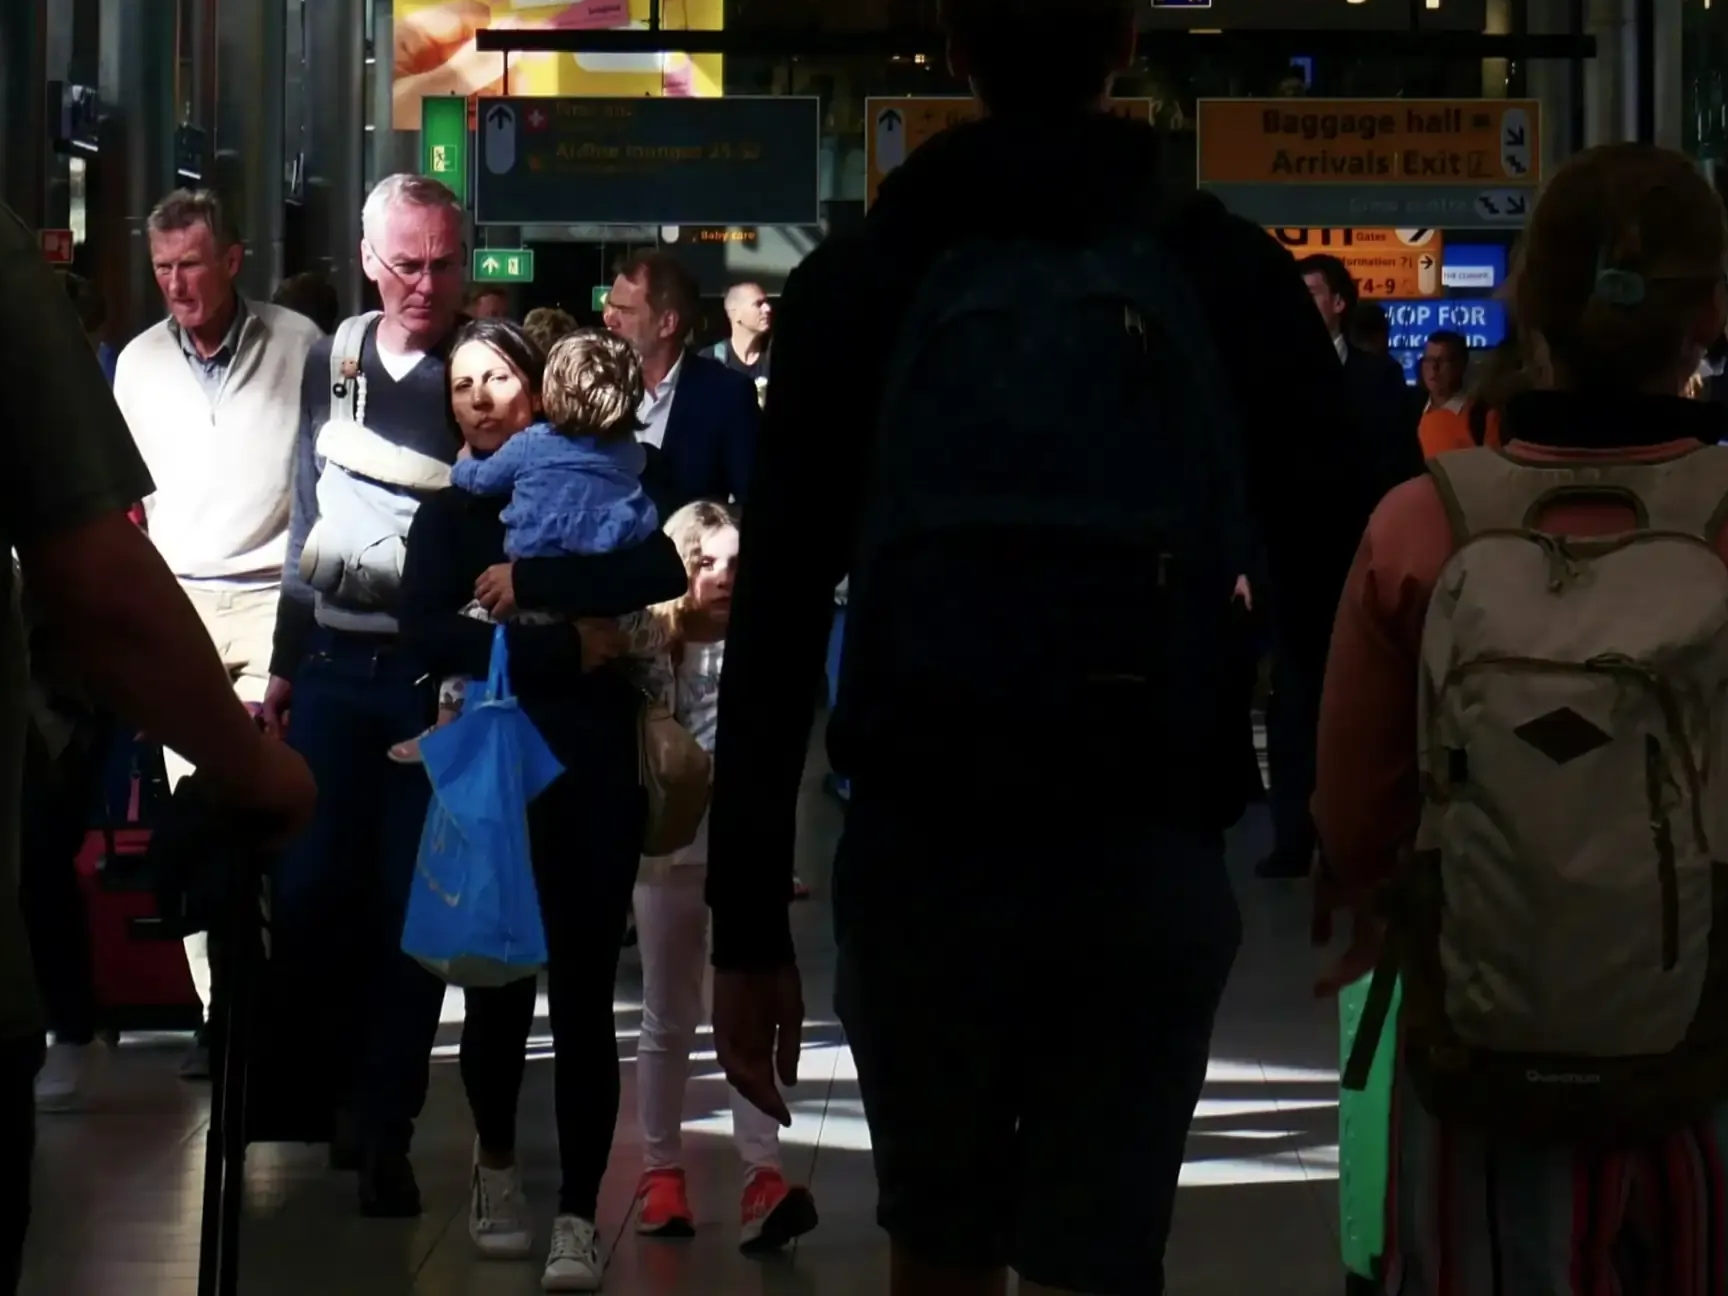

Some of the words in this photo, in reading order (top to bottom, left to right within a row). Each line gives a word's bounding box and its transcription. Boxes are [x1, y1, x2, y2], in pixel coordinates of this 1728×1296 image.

[1263, 109, 1395, 140] Baggage
[1406, 108, 1462, 134] hall
[1272, 149, 1390, 176] Arrivals
[1403, 150, 1462, 176] Exit
[1356, 232, 1386, 241] Gates
[1438, 306, 1486, 326] FOR
